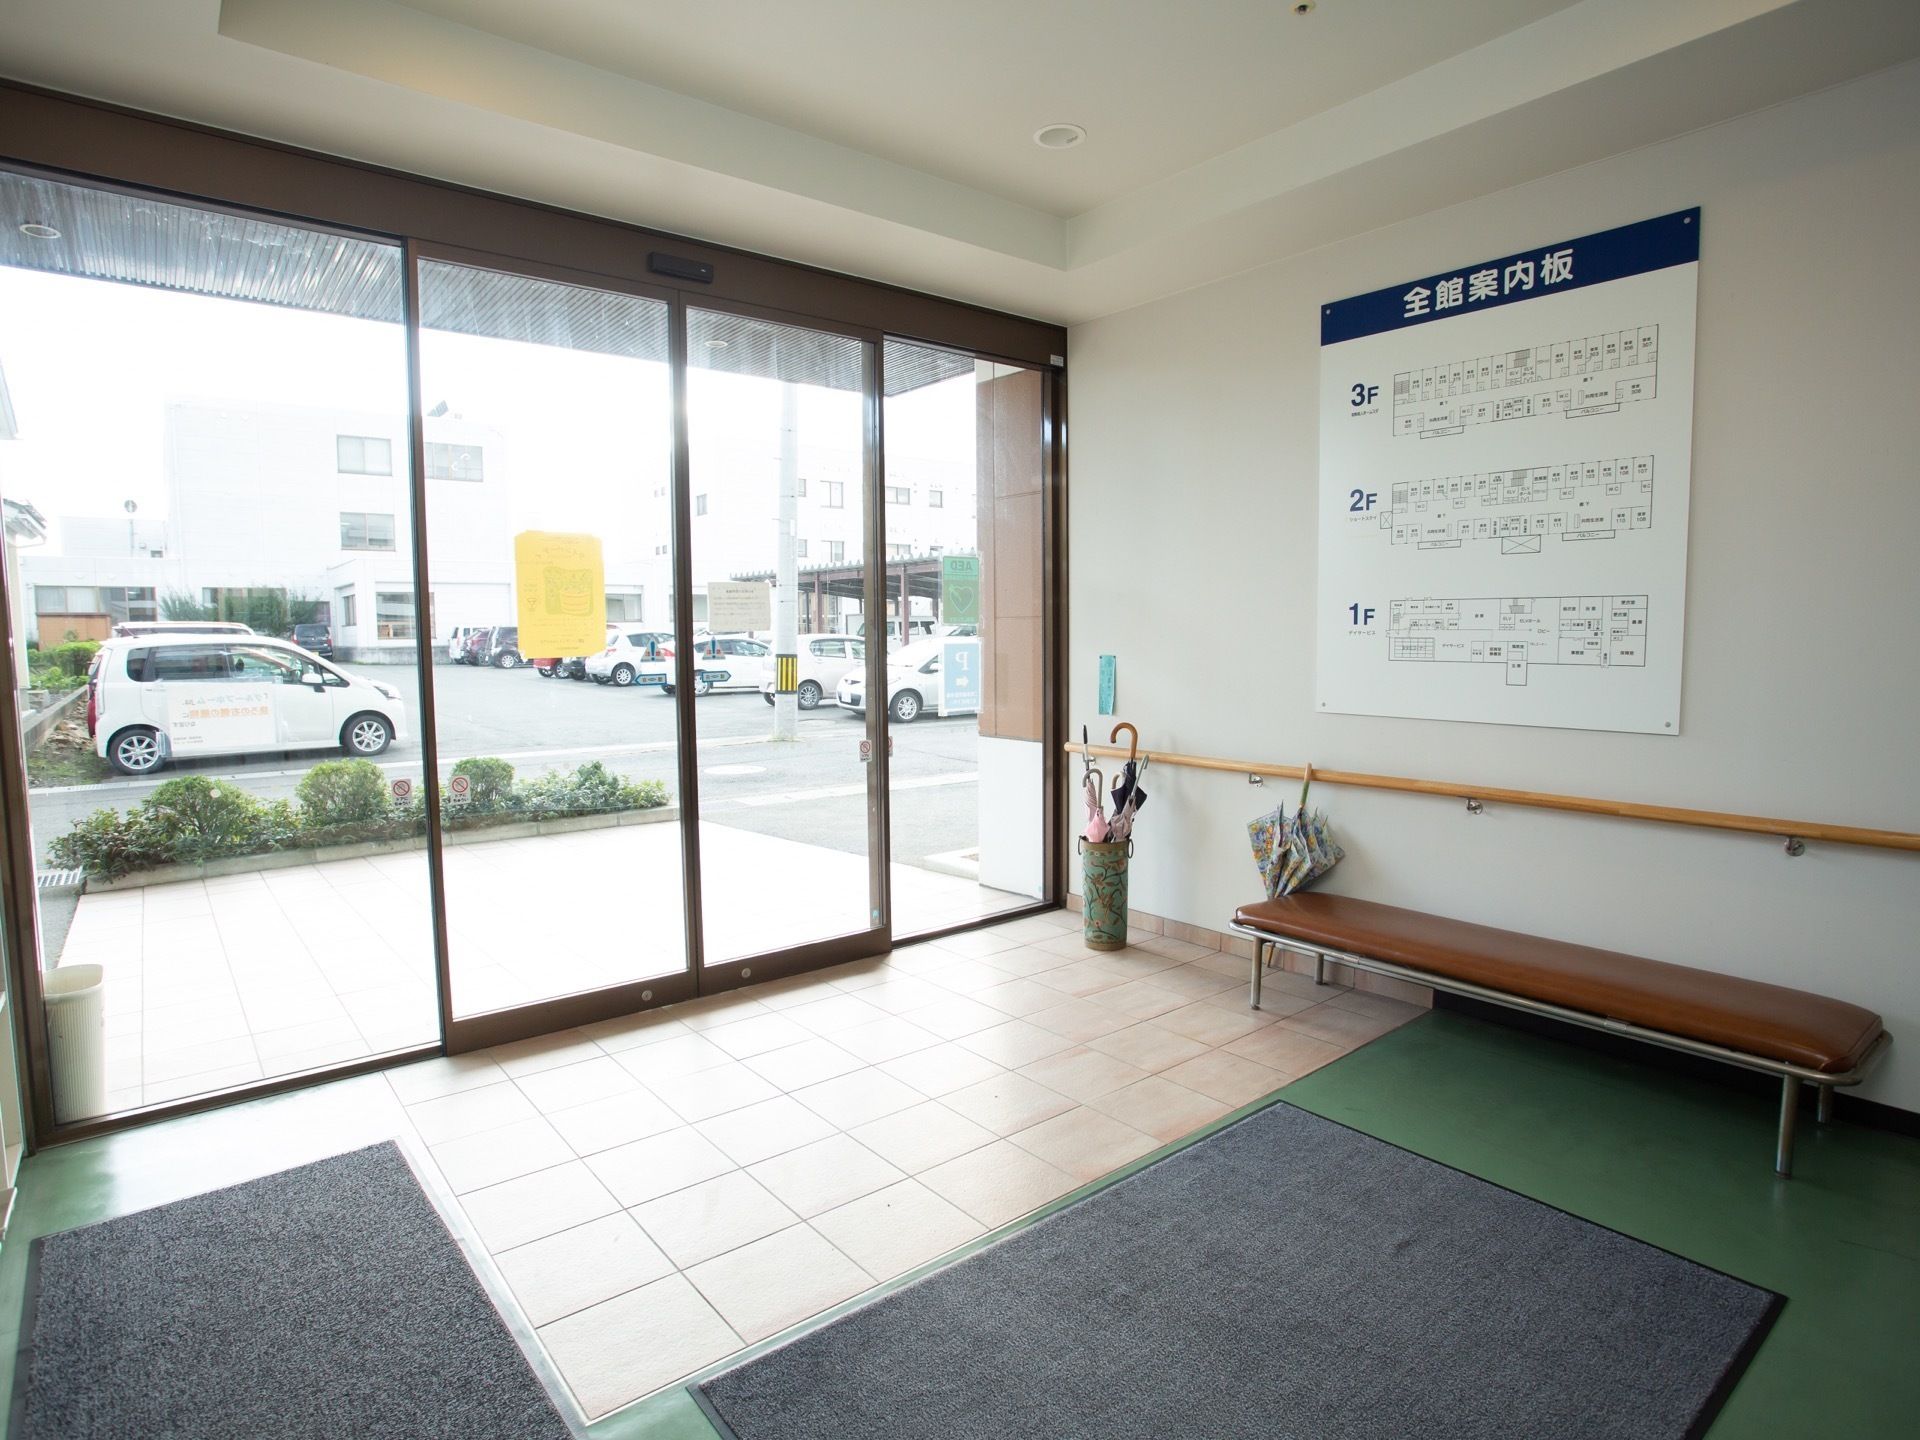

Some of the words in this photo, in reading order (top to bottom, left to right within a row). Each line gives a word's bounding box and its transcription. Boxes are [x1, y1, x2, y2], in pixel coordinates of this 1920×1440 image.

[1403, 248, 1574, 318] 全館案内板
[1351, 383, 1379, 407] 3F
[1350, 489, 1378, 512] 2F
[1349, 602, 1376, 626] 1F
